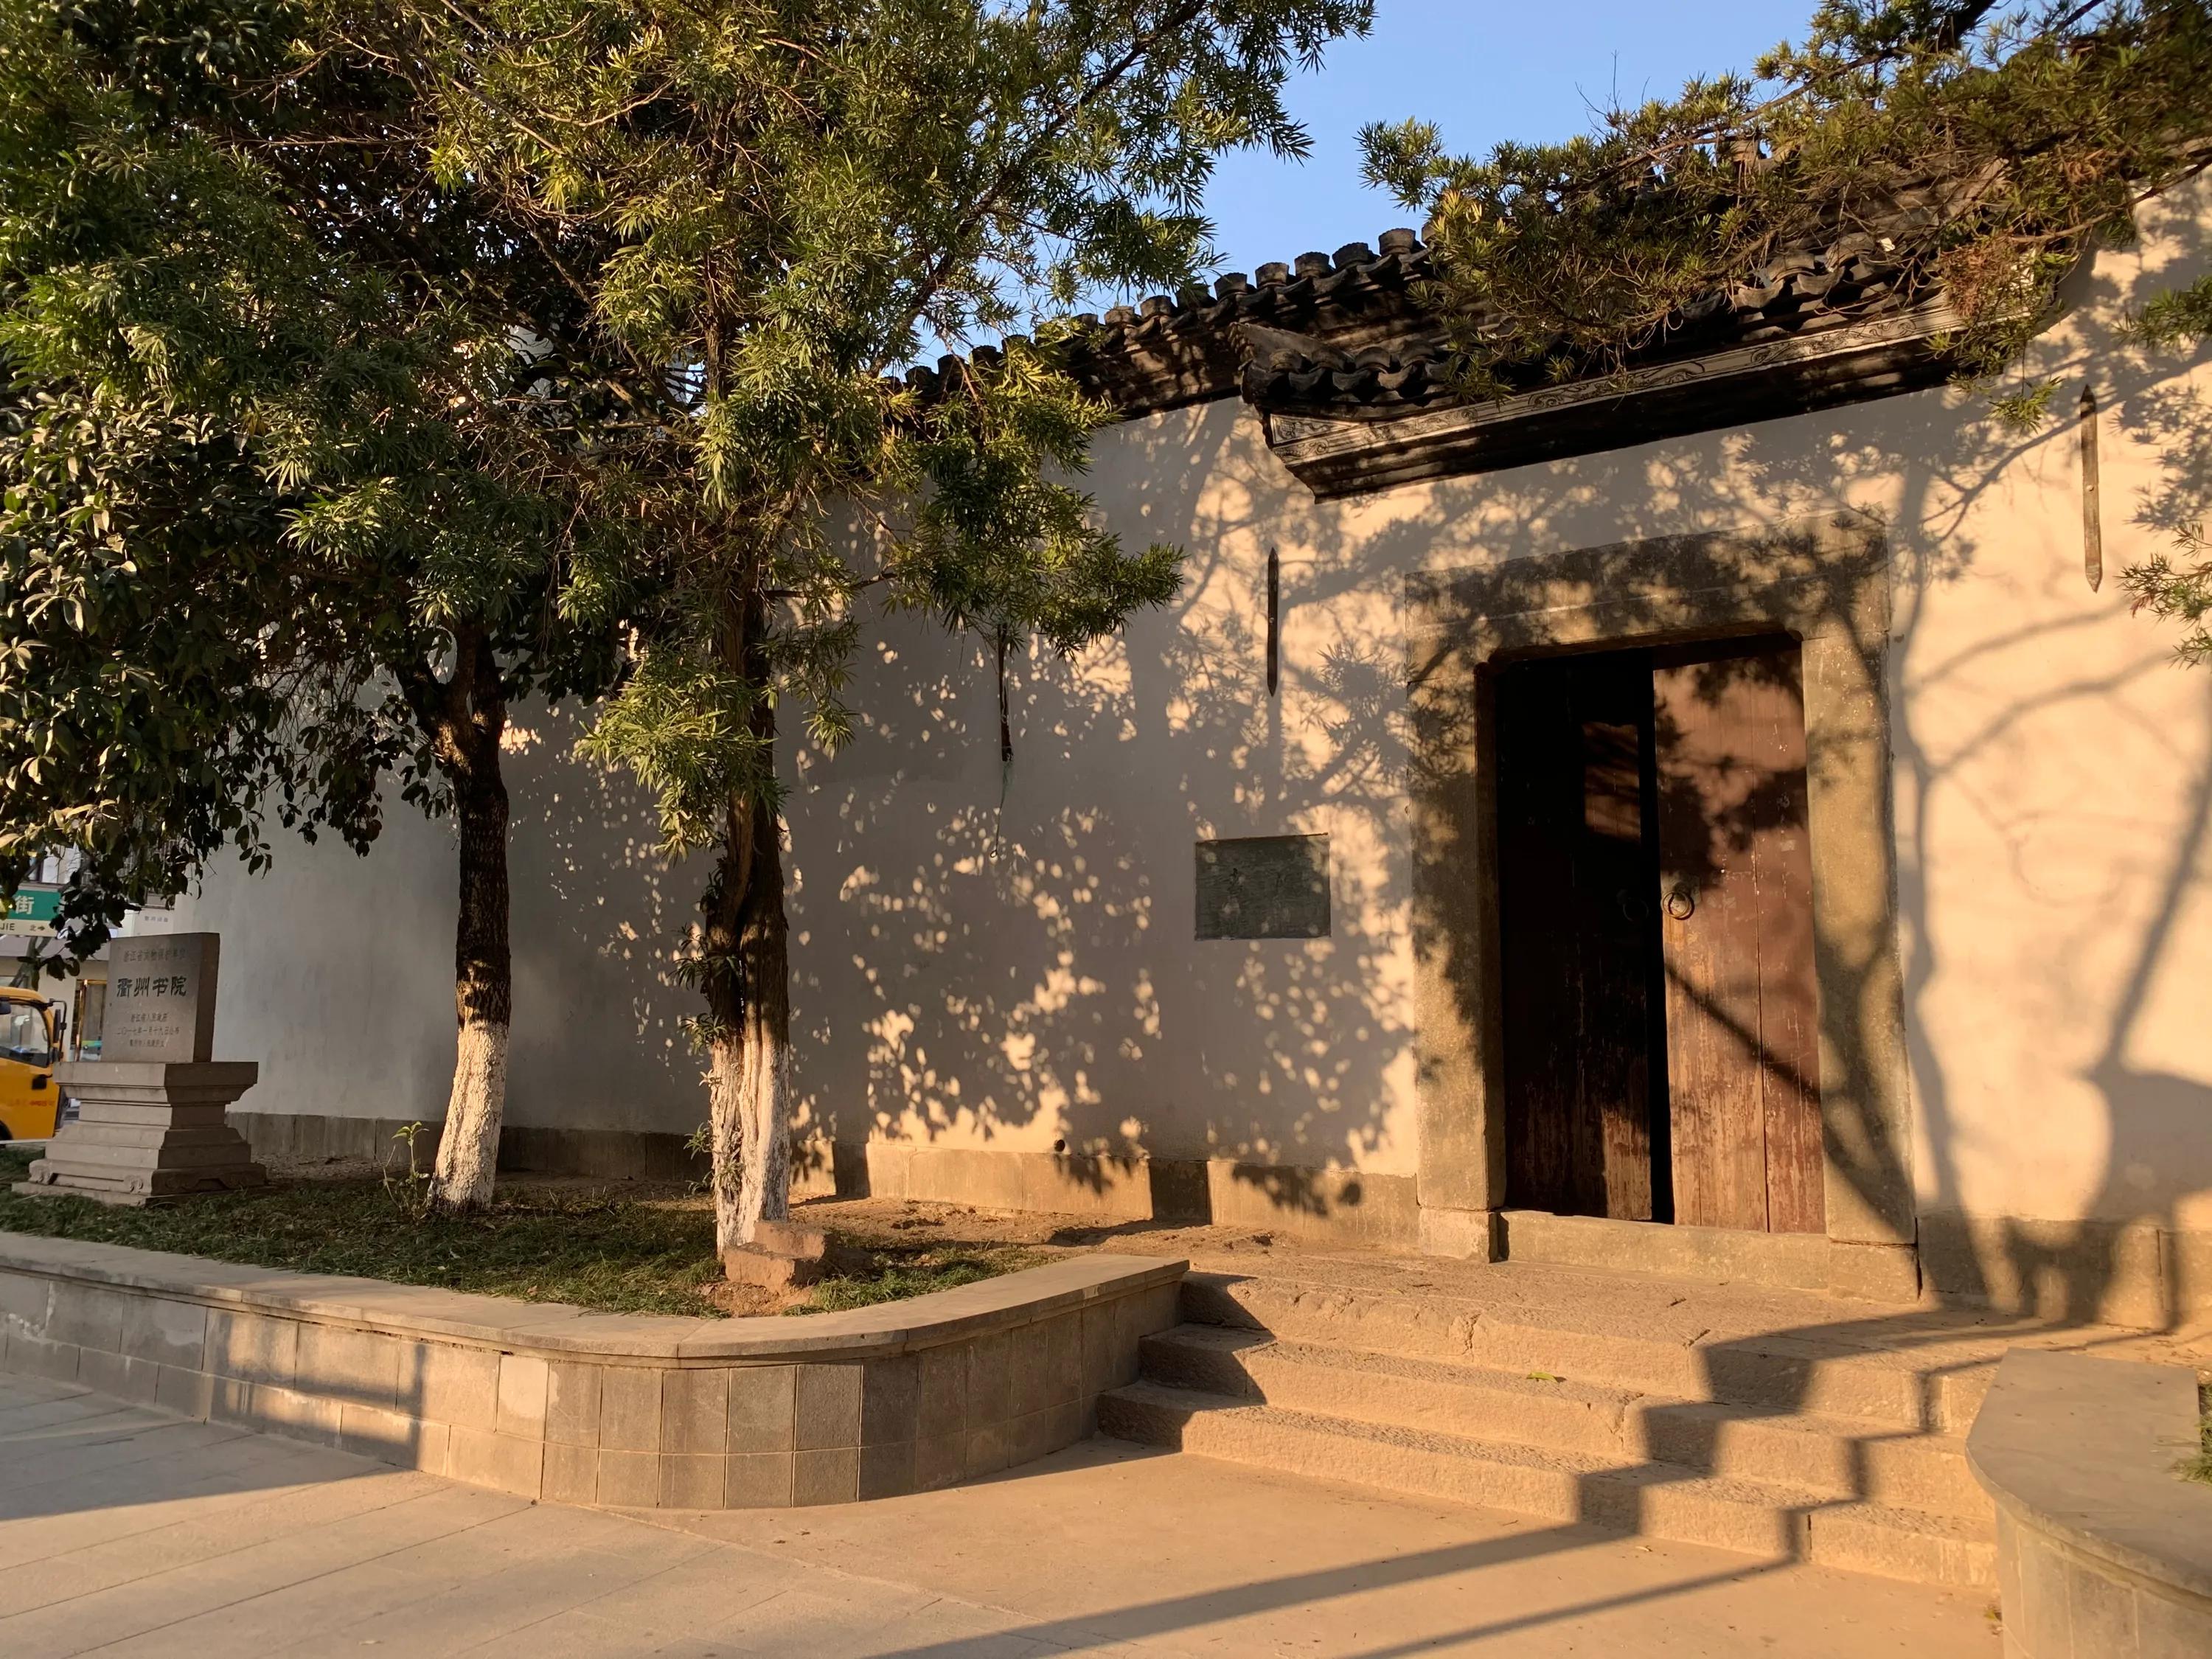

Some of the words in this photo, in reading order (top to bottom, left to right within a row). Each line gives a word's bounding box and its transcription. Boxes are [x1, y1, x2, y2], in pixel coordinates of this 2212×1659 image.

[15, 895, 35, 914] 街
[116, 975, 187, 998] 衢州书院
